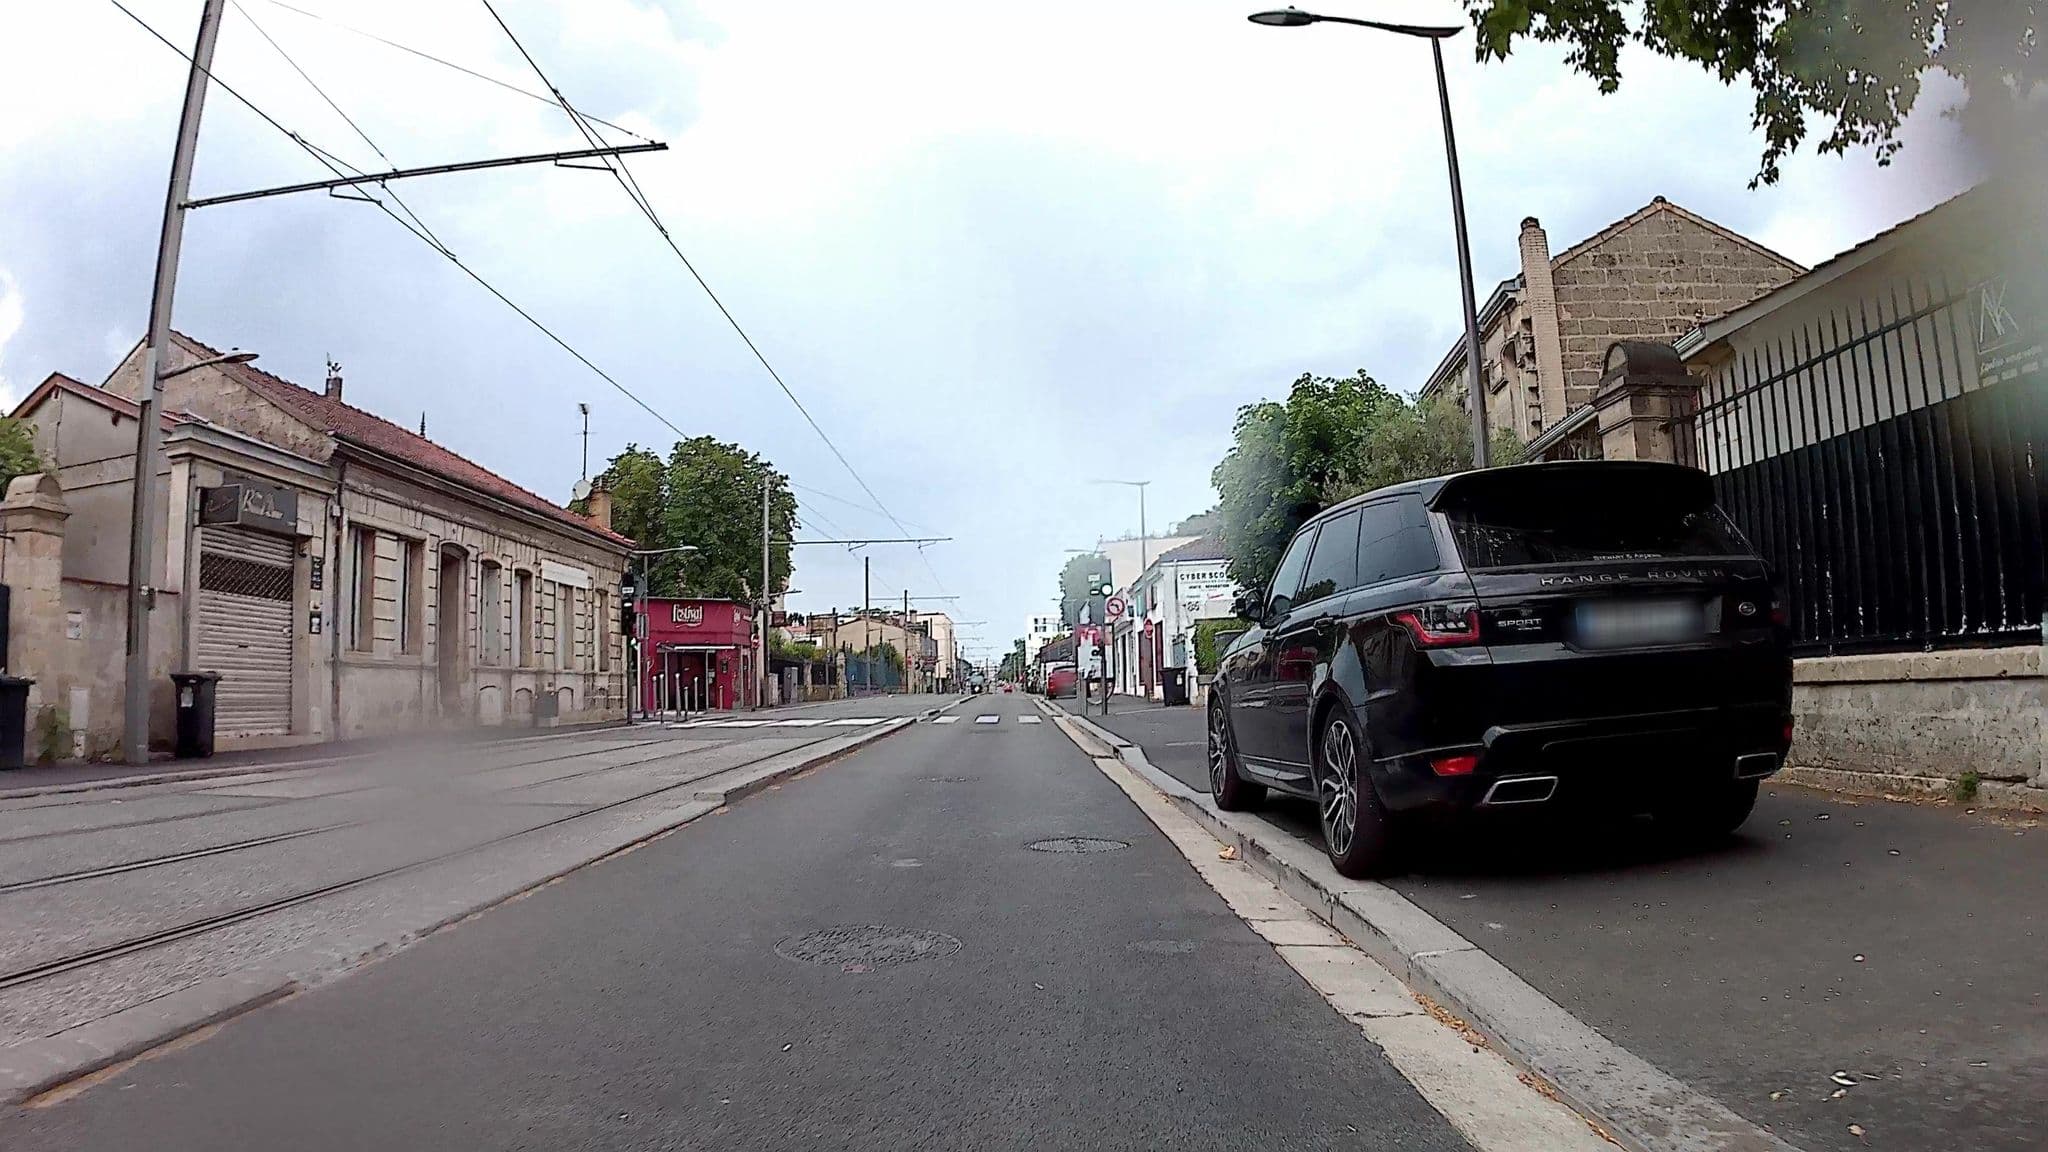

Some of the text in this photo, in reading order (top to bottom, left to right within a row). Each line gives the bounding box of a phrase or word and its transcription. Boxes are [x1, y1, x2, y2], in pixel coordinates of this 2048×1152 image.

[1180, 572, 1207, 581] CYBER
[1540, 570, 1725, 587] RANGE ROVER
[1497, 618, 1542, 627] SPORT
